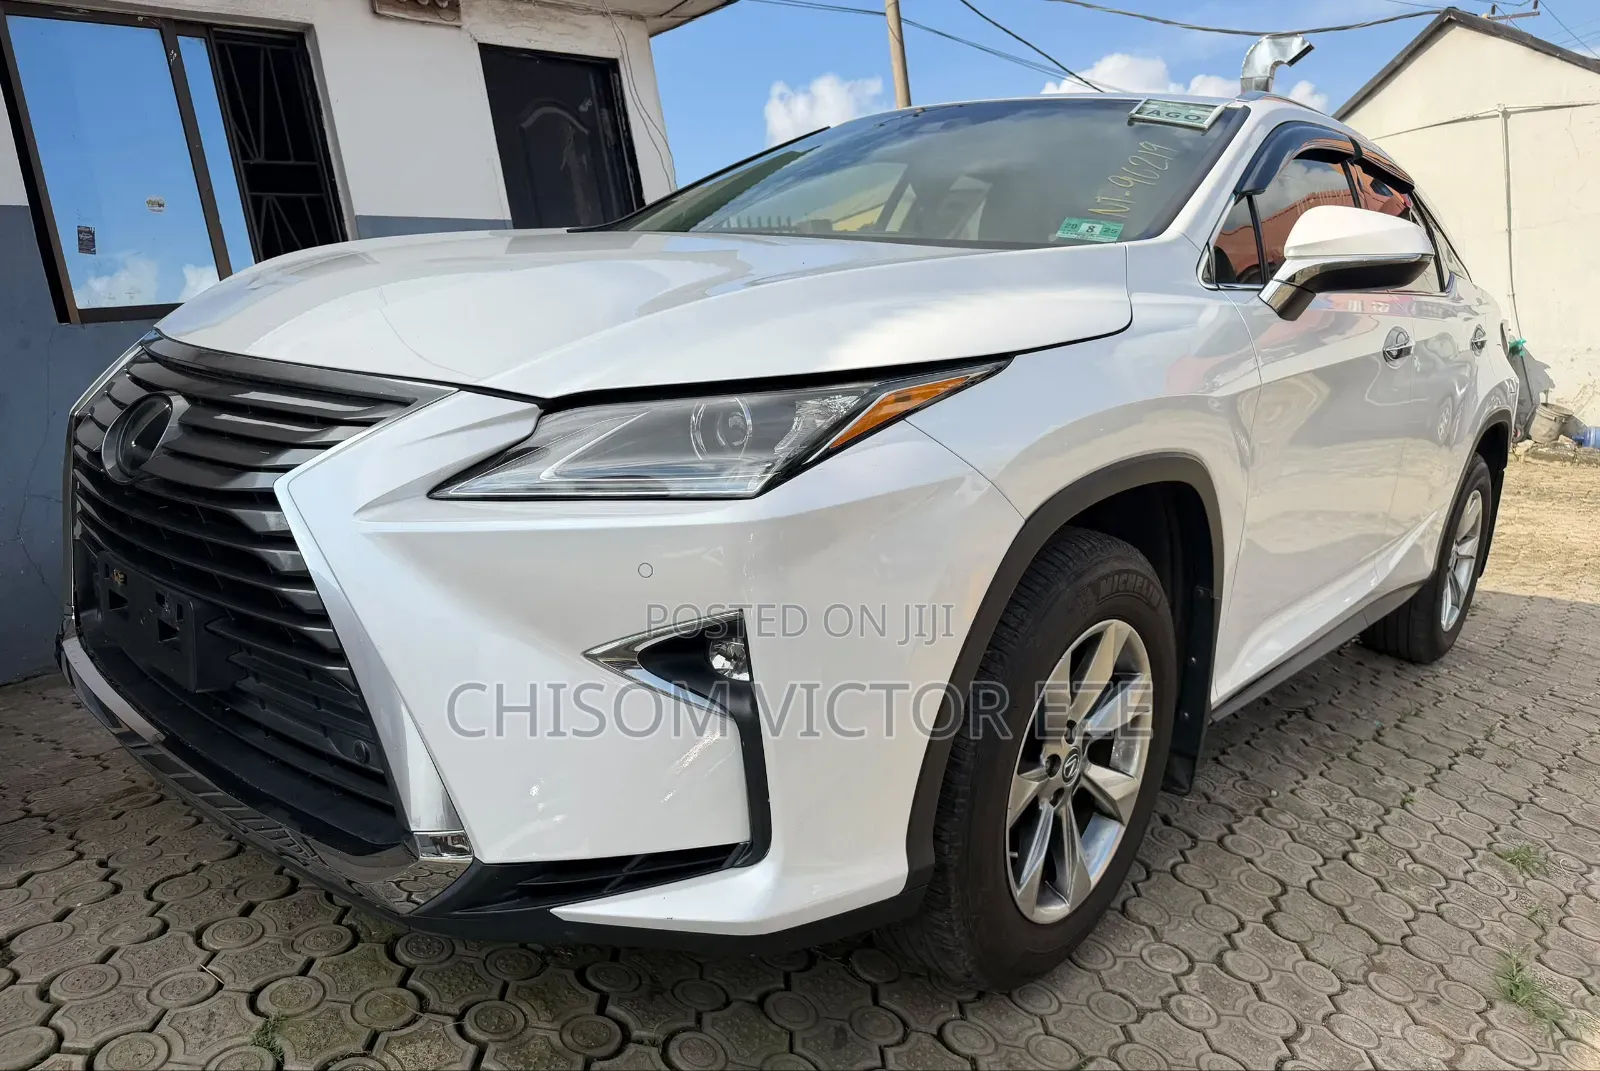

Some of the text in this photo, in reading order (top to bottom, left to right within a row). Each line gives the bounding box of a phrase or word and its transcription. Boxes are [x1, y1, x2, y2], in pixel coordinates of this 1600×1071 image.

[1063, 222, 1118, 235] 20 8 25
